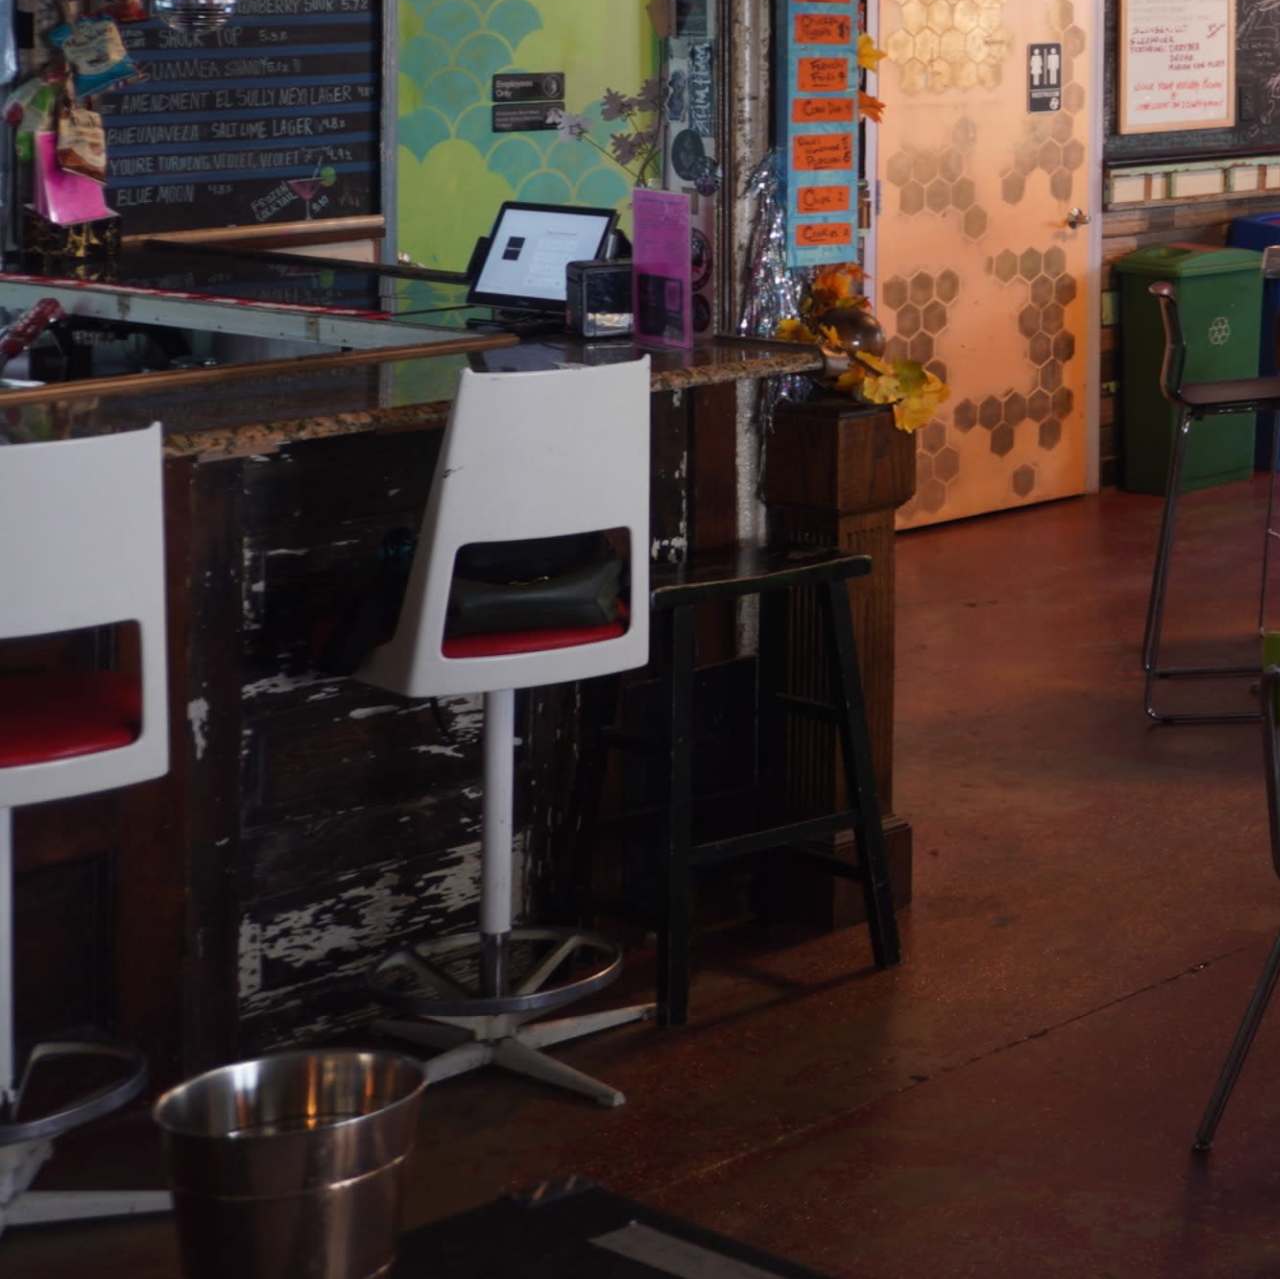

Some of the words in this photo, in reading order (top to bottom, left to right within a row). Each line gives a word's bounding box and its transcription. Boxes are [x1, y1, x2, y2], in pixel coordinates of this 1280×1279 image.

[120, 91, 210, 115] AMENDMENT
[309, 84, 353, 105] LAGER
[272, 116, 314, 137] LAGER
[116, 186, 153, 207] BLUE
[156, 183, 195, 205] MOON
